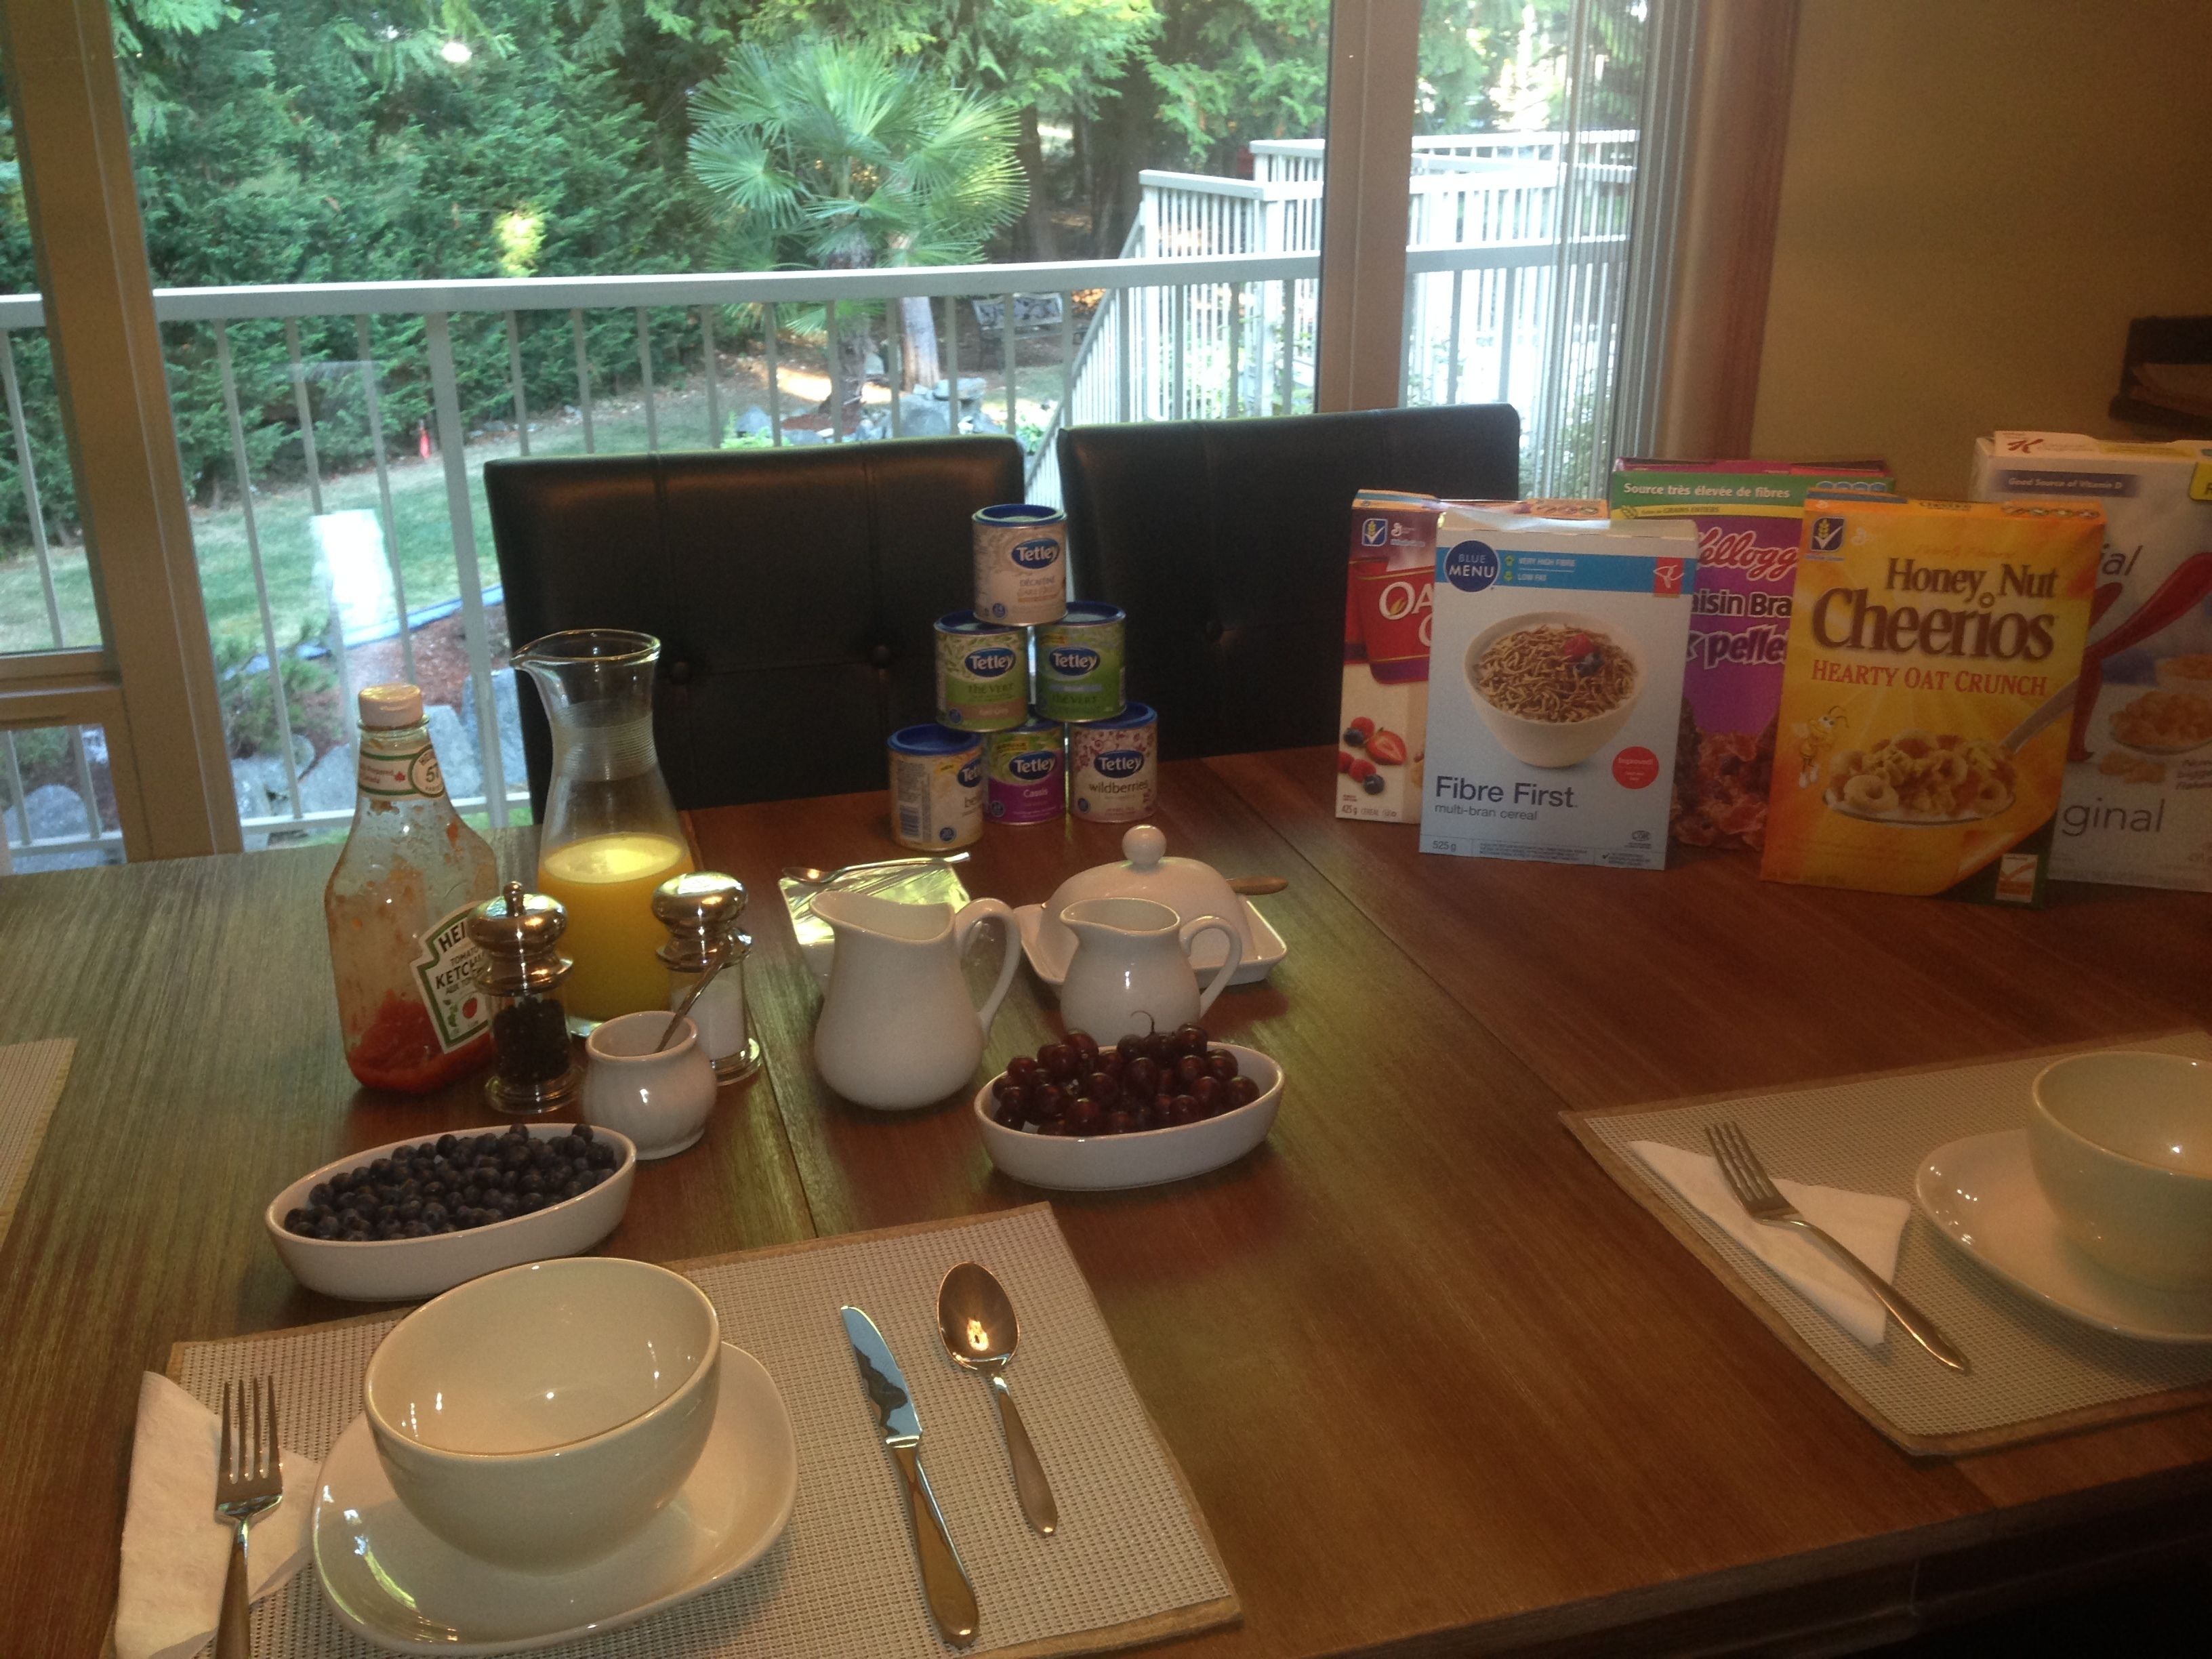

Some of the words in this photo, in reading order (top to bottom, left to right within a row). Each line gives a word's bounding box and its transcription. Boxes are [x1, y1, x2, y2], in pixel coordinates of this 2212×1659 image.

[1623, 483, 1664, 495] Source
[1667, 485, 1691, 495] très
[1694, 485, 1733, 497] élevée
[1736, 487, 1751, 497] de
[1755, 487, 1790, 498] fibres
[1016, 545, 1057, 562] Tetley
[1458, 553, 1486, 564] BLUE
[1448, 564, 1495, 579] MENU
[1886, 557, 1986, 602] Honey
[1999, 562, 2059, 599] Nut
[1748, 591, 1793, 619] Bra
[1812, 587, 2055, 663] Cheerios
[970, 655, 1014, 671] Tetley
[1052, 653, 1097, 672] Tetley
[1811, 659, 1899, 687] HEARTY
[1904, 667, 1950, 691] OAT
[1954, 671, 2047, 697] CRUNCH
[1013, 758, 1056, 774] Tetley
[1098, 755, 1143, 772] Tetley
[1023, 787, 1048, 798] Cassis
[1088, 779, 1149, 794] wildberries
[1435, 775, 1504, 803] Fibre
[1513, 781, 1575, 808] First
[1434, 803, 1496, 818] multi-bran
[1500, 809, 1538, 821] cereal
[2062, 797, 2165, 836] ginal
[1432, 840, 1449, 851] 525
[1450, 842, 1456, 852] g
[438, 921, 466, 953] HEI
